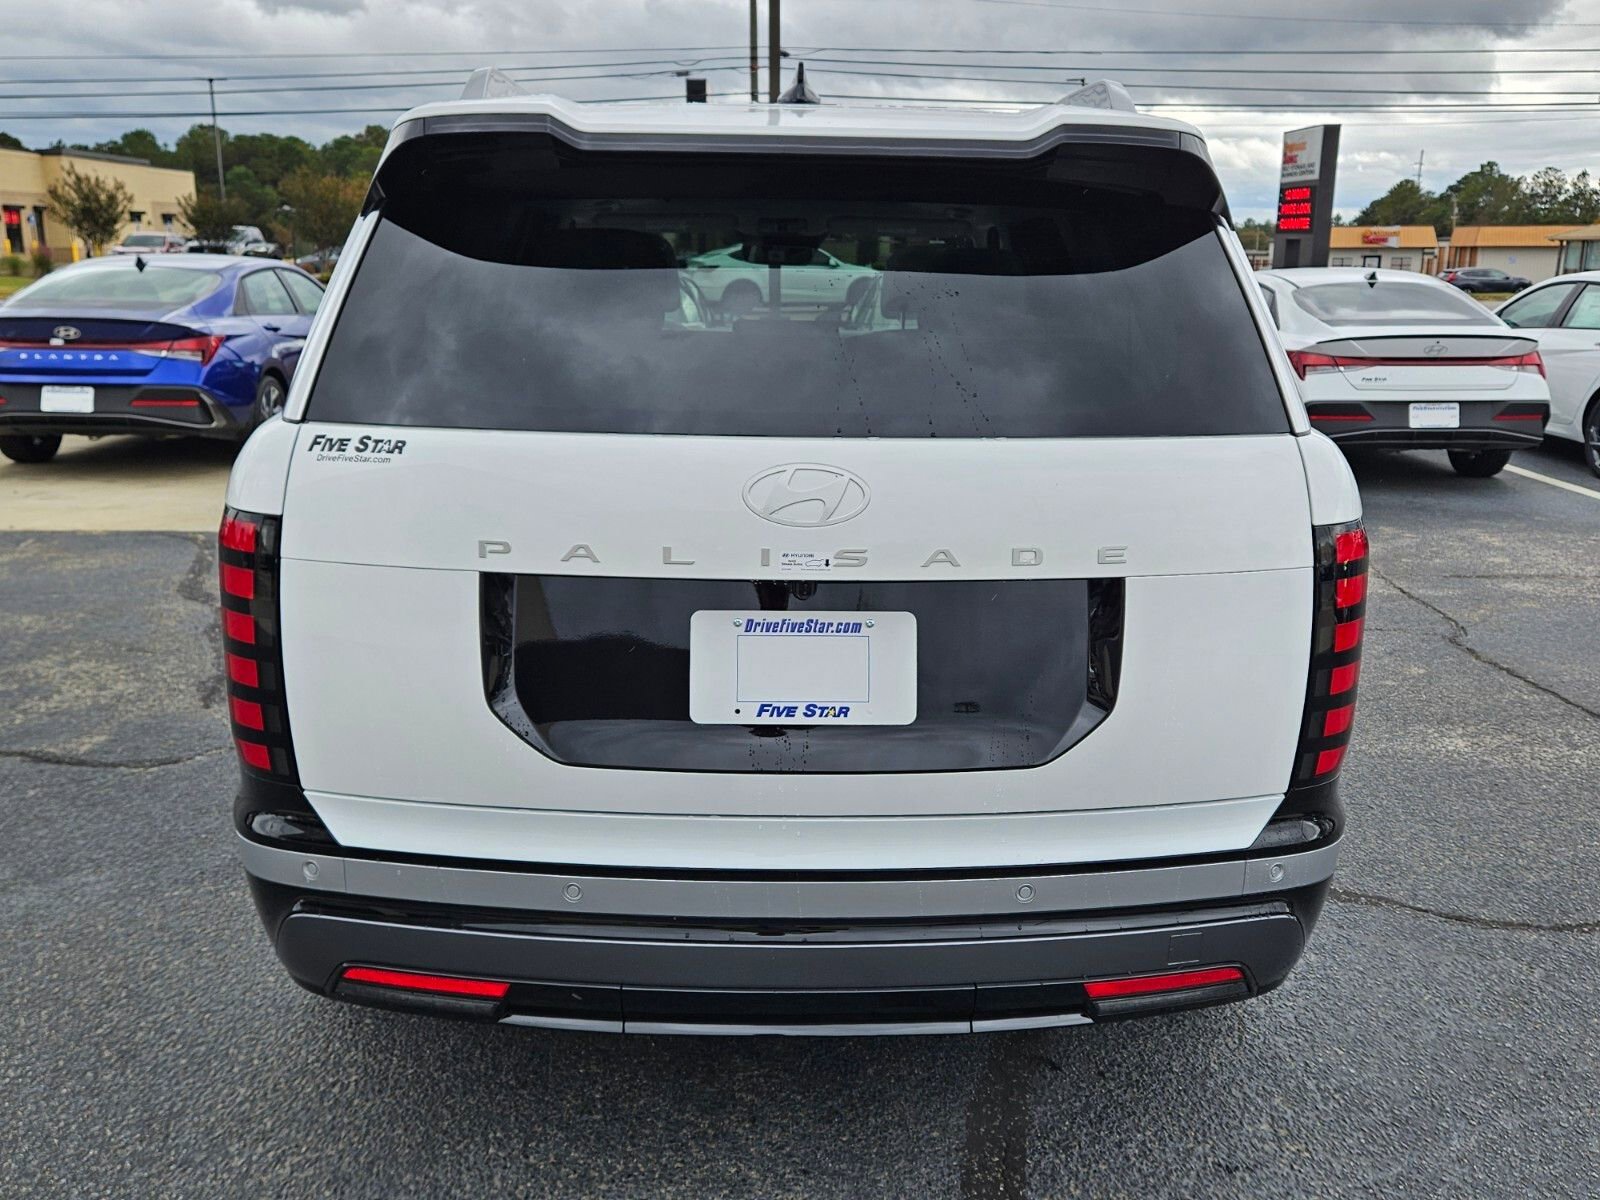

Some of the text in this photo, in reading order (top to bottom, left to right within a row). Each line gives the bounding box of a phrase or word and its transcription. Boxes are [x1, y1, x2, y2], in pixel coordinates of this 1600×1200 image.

[308, 435, 406, 454] FIVE STAR
[317, 454, 391, 463] DriveFiveStar.com
[478, 540, 1129, 568] PALISADE
[744, 619, 862, 633] DriveFiveStar.com
[756, 704, 850, 718] FIVE STAR
